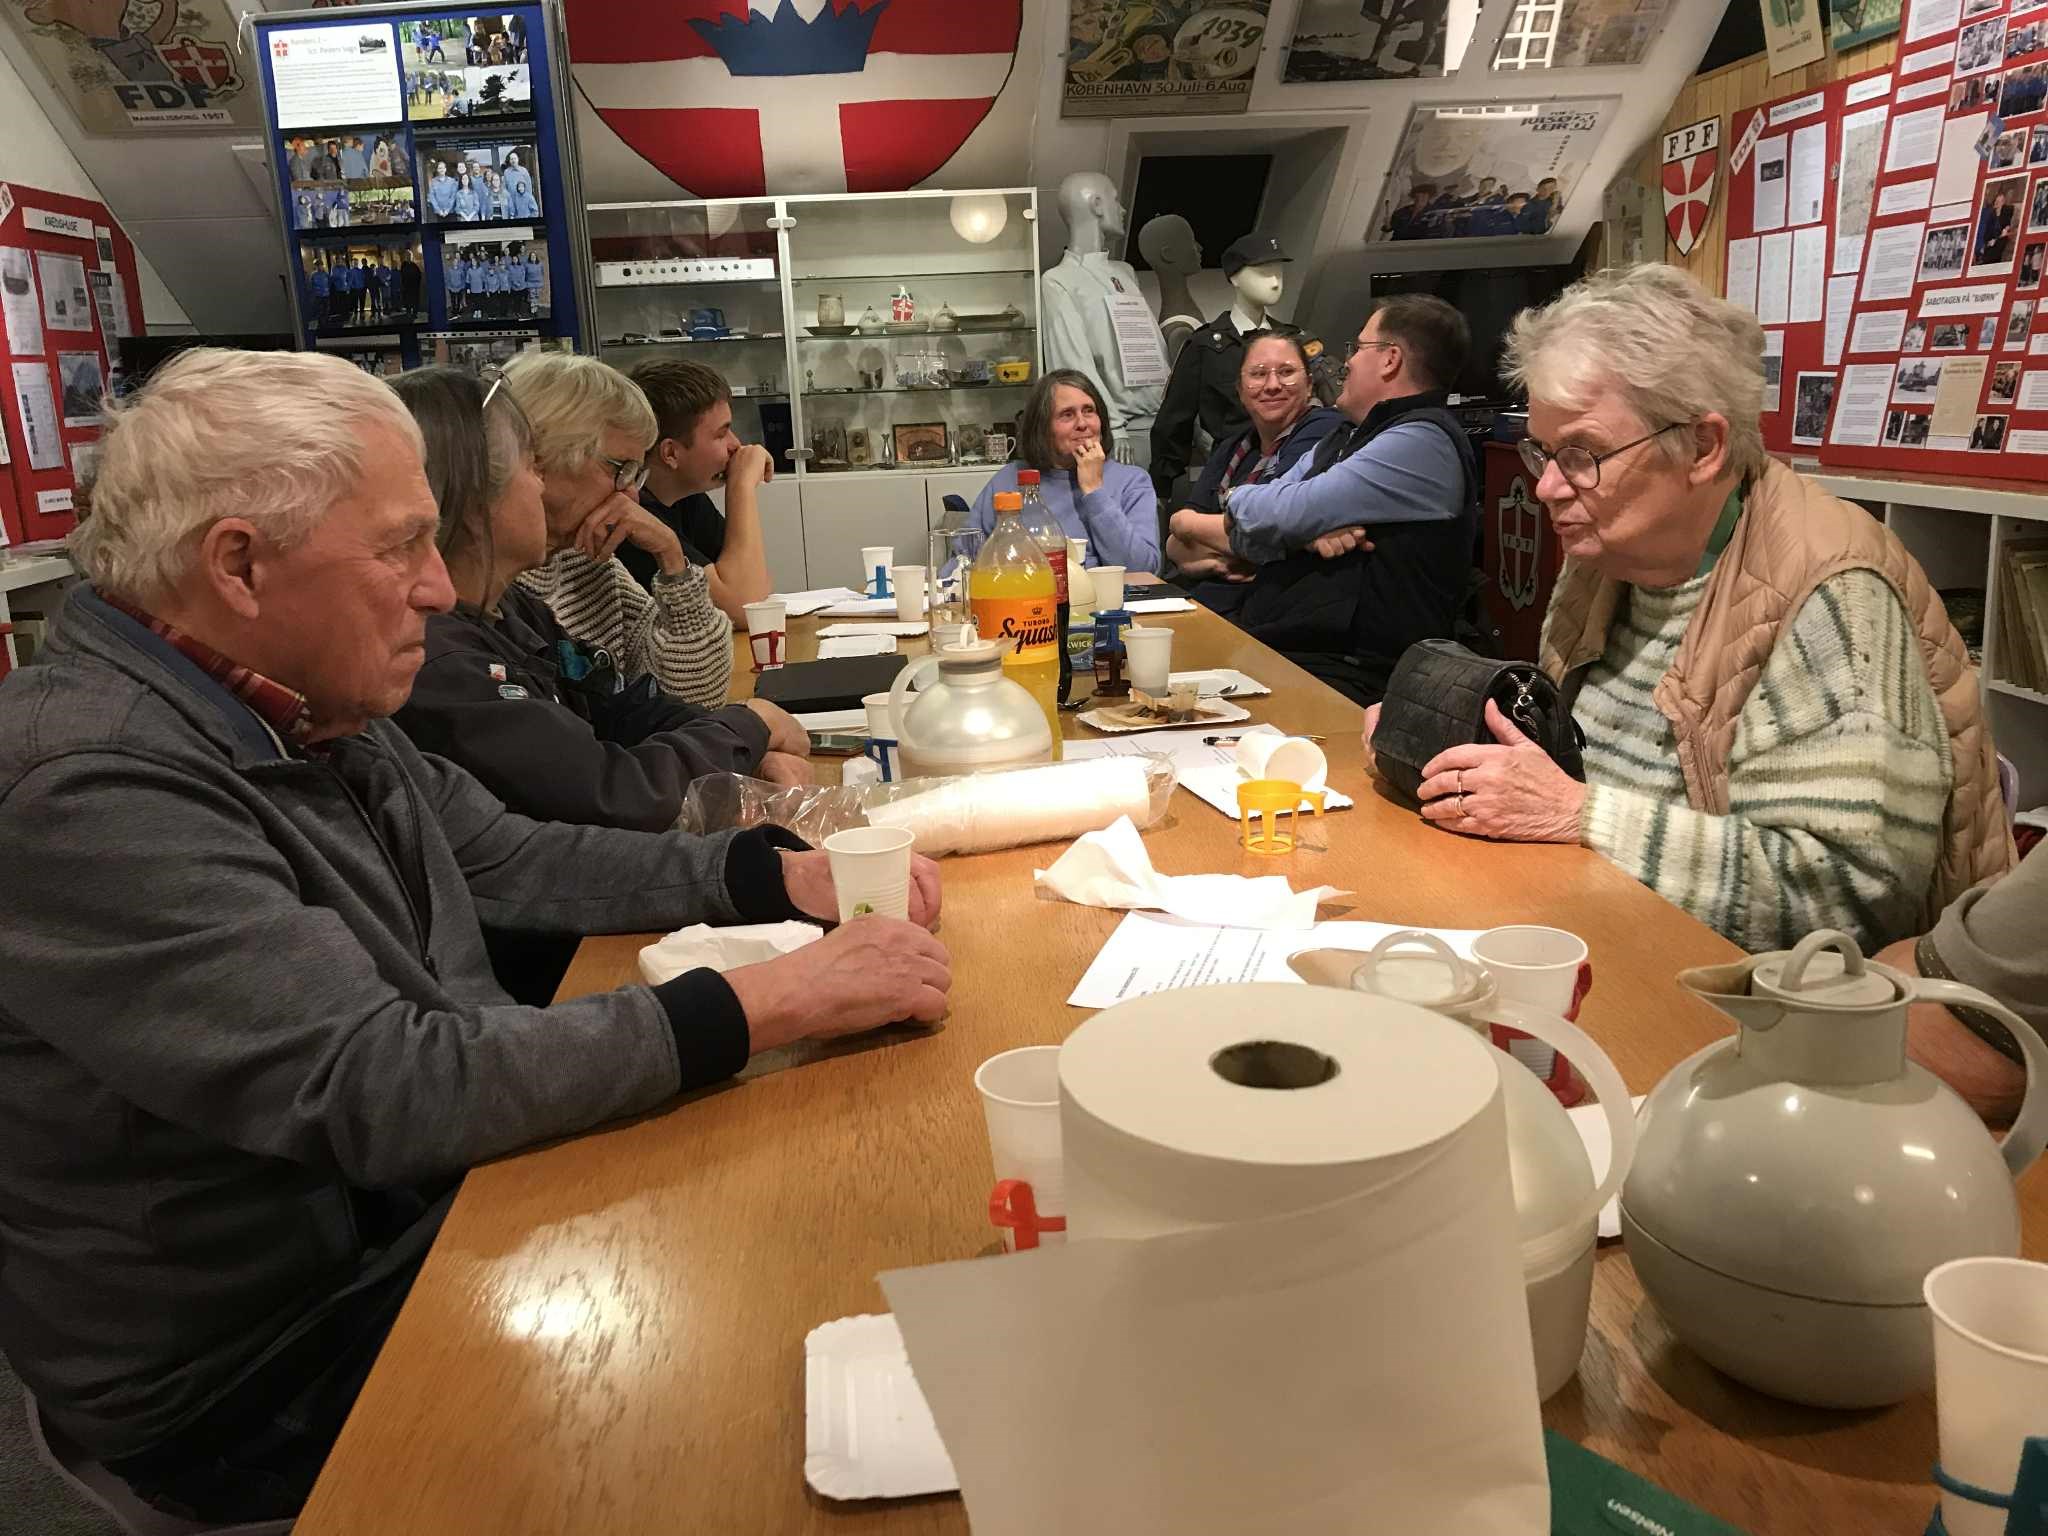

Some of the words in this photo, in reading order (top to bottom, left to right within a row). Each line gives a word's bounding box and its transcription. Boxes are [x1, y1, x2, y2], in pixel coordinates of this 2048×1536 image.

[1202, 16, 1263, 48] 1939
[113, 84, 210, 109] FDF
[1066, 81, 1150, 96] KØBENHAVN
[1668, 123, 1714, 158] FPF
[1023, 617, 1050, 628] TUBORG
